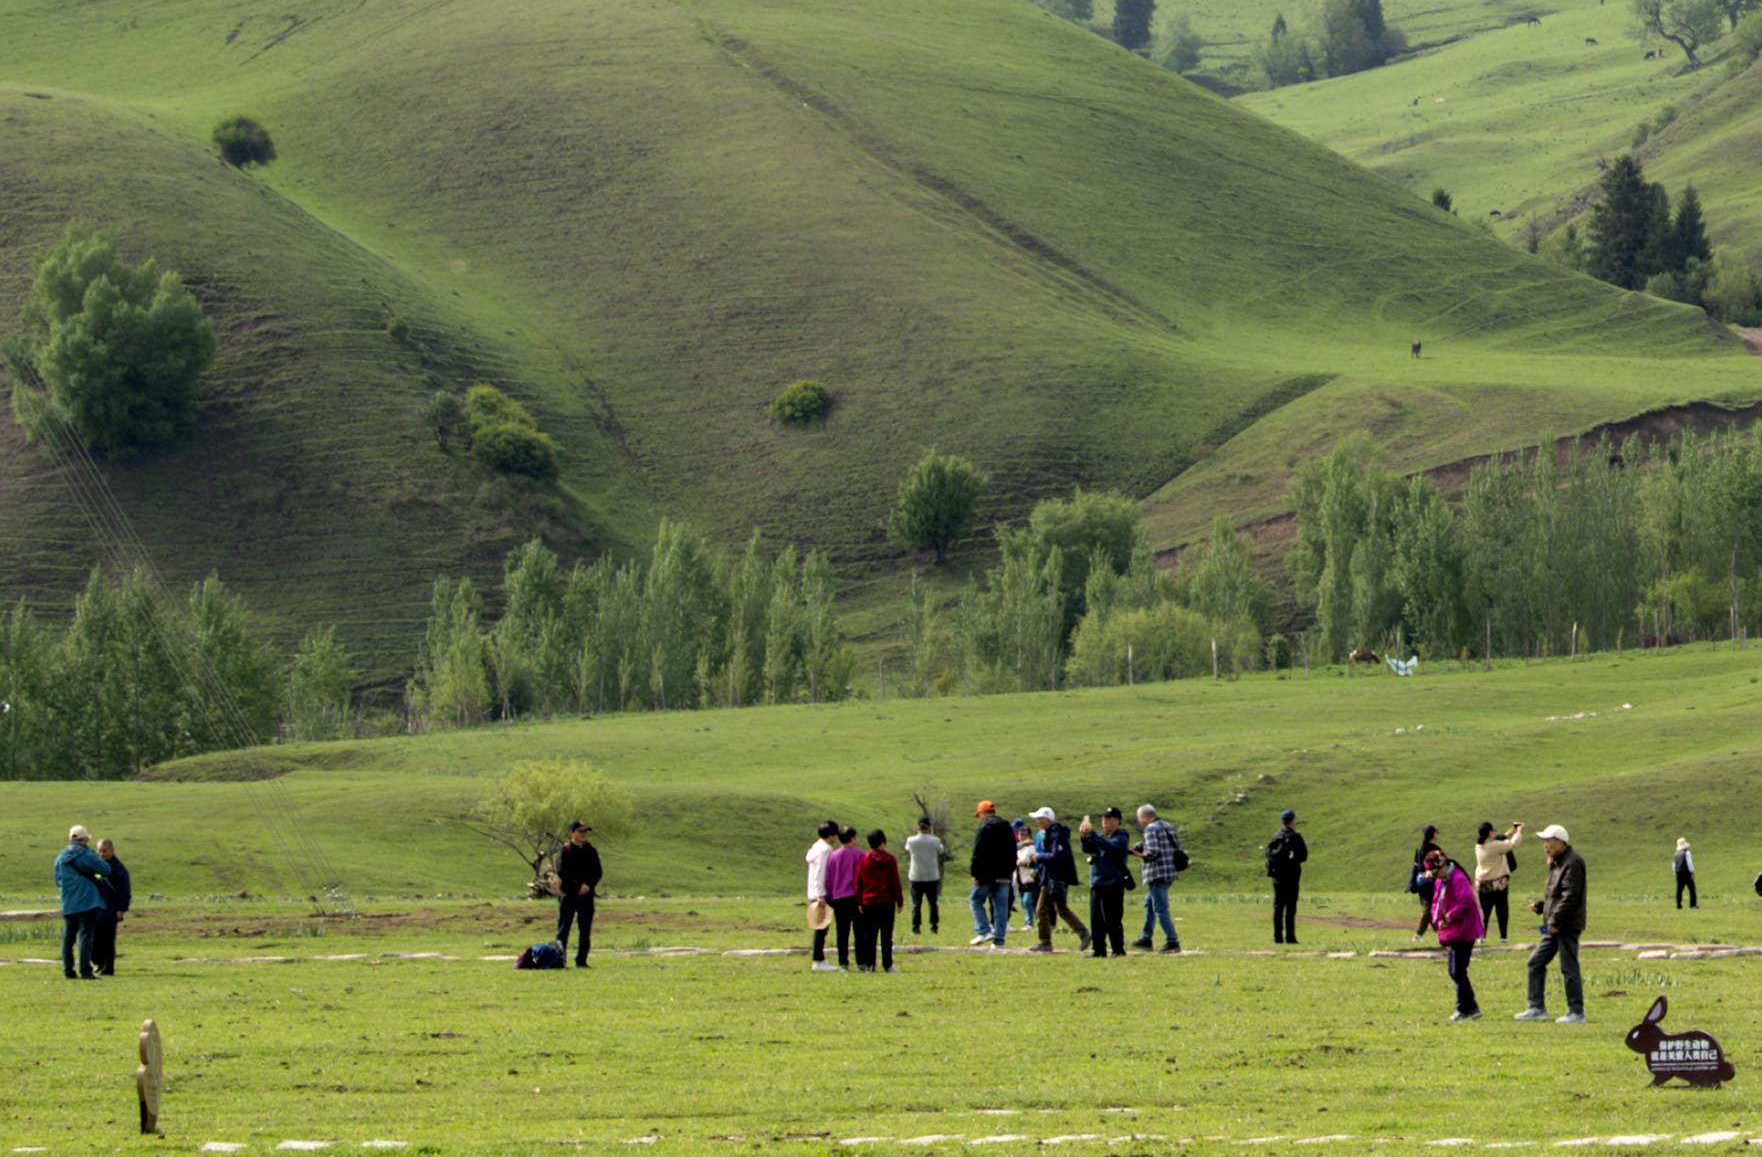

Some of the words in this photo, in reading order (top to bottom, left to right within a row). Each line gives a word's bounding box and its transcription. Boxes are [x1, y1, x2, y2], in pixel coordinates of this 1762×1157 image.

[1659, 1040, 1710, 1050] 保护野生动物
